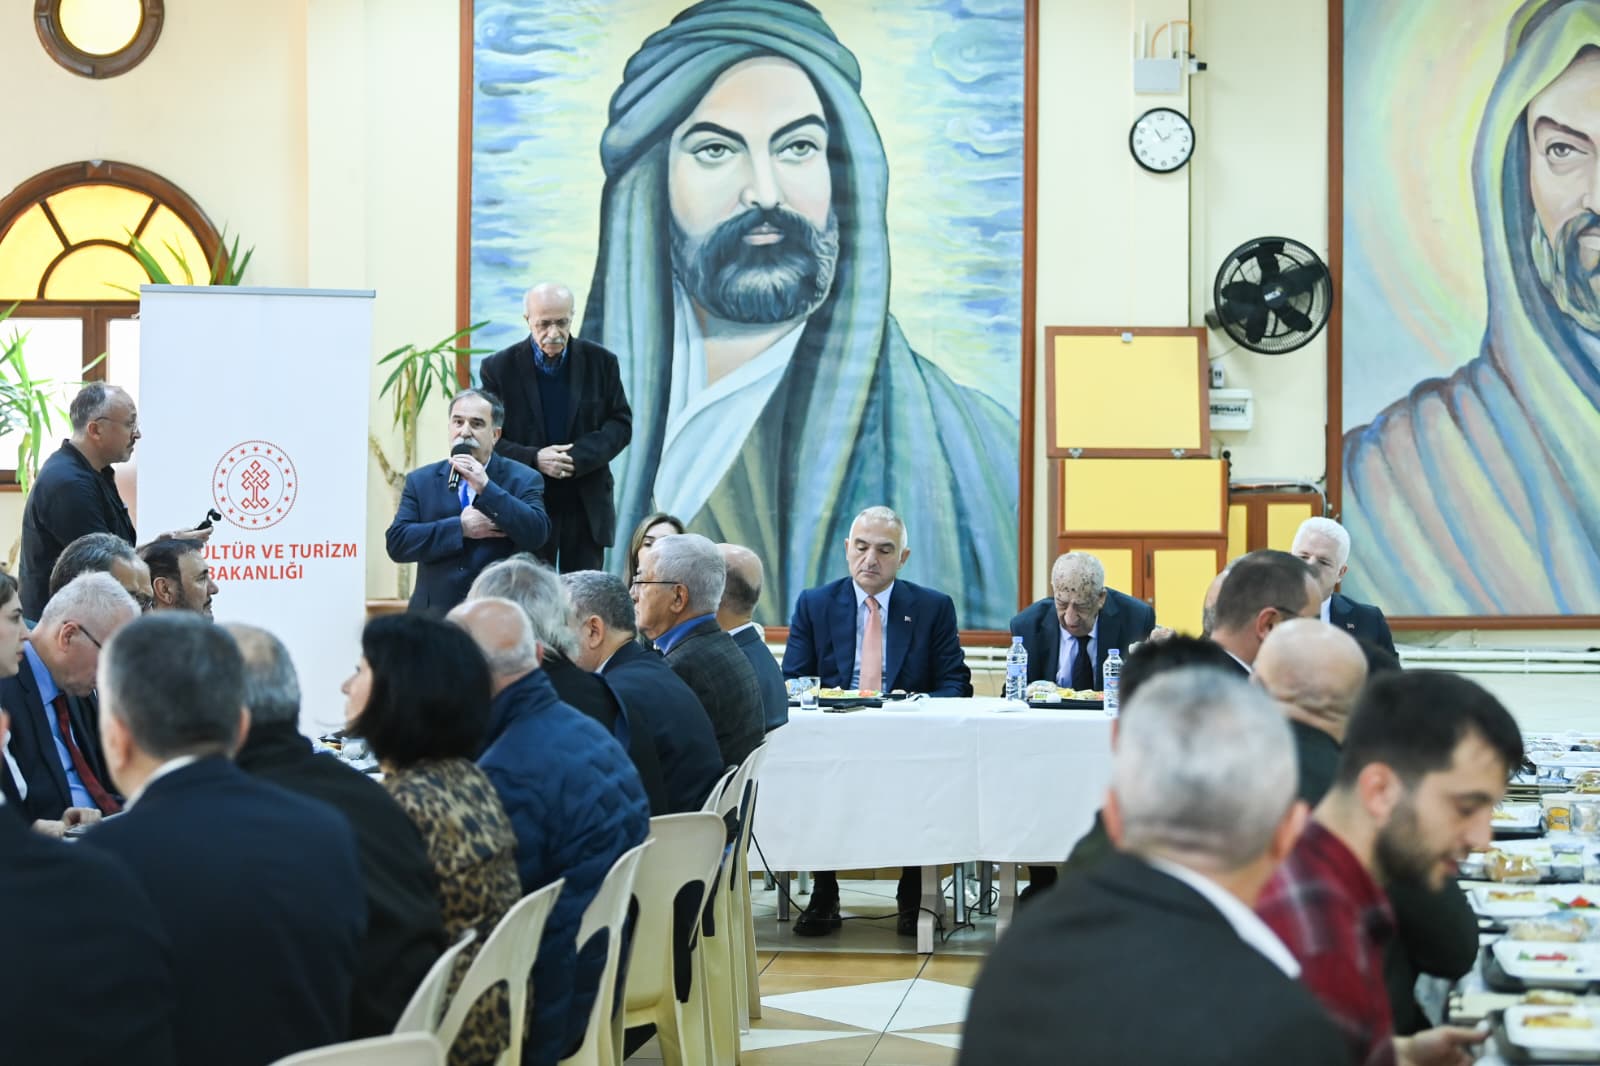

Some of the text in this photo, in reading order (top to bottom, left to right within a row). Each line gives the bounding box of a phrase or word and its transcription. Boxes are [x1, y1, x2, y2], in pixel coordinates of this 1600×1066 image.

[261, 543, 284, 559] VE
[290, 540, 358, 559] TURİZM
[208, 562, 304, 581] BAKANLIĞI
